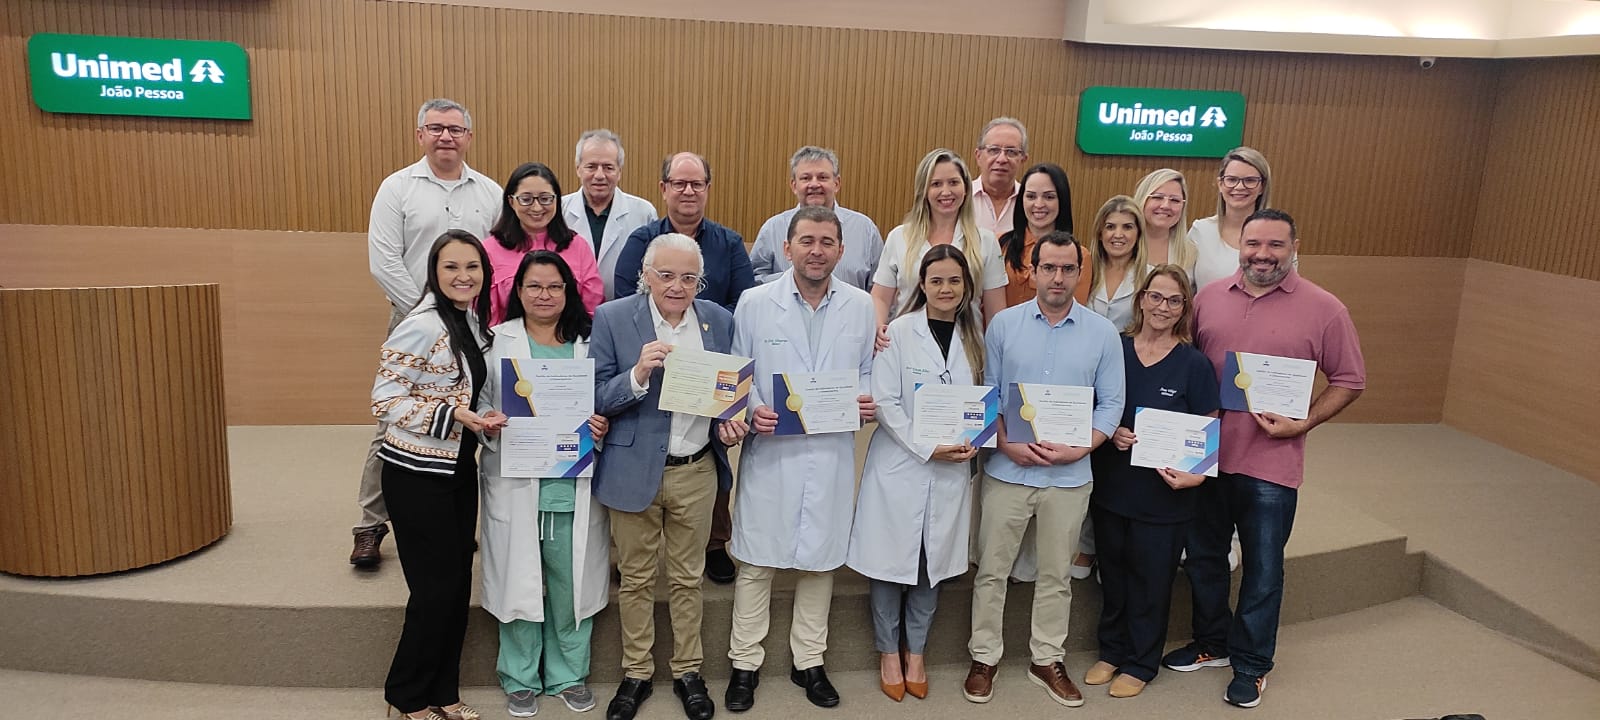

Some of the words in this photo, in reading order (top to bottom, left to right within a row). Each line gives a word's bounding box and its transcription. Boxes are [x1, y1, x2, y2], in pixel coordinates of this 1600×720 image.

[51, 52, 183, 82] Unimed
[100, 85, 133, 98] João
[135, 86, 184, 100] Pessoa
[1098, 102, 1197, 127] Unimed
[1129, 129, 1154, 141] João
[1155, 130, 1193, 142] Pessoa
